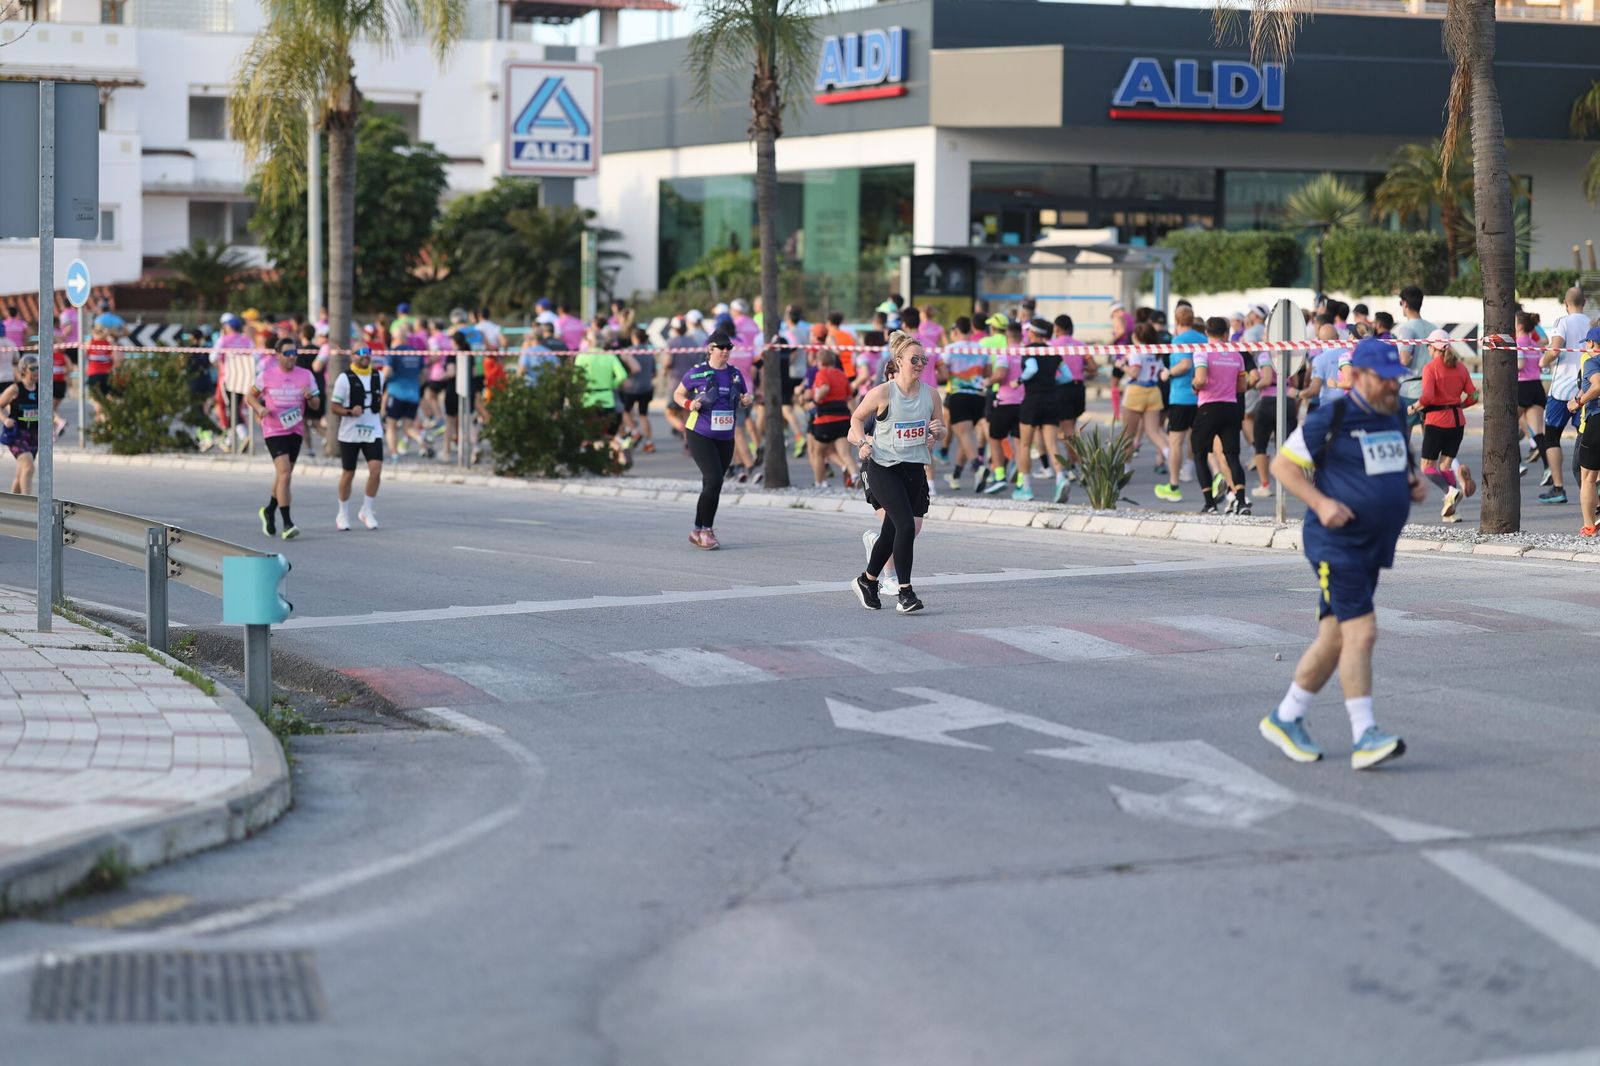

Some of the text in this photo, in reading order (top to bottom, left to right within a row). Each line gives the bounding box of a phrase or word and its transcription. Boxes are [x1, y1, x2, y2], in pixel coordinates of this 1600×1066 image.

[815, 27, 907, 91] ALDI
[1112, 57, 1285, 111] ALDI
[521, 142, 584, 160] ALDI
[896, 427, 925, 439] 1458
[1367, 442, 1404, 460] 1536
